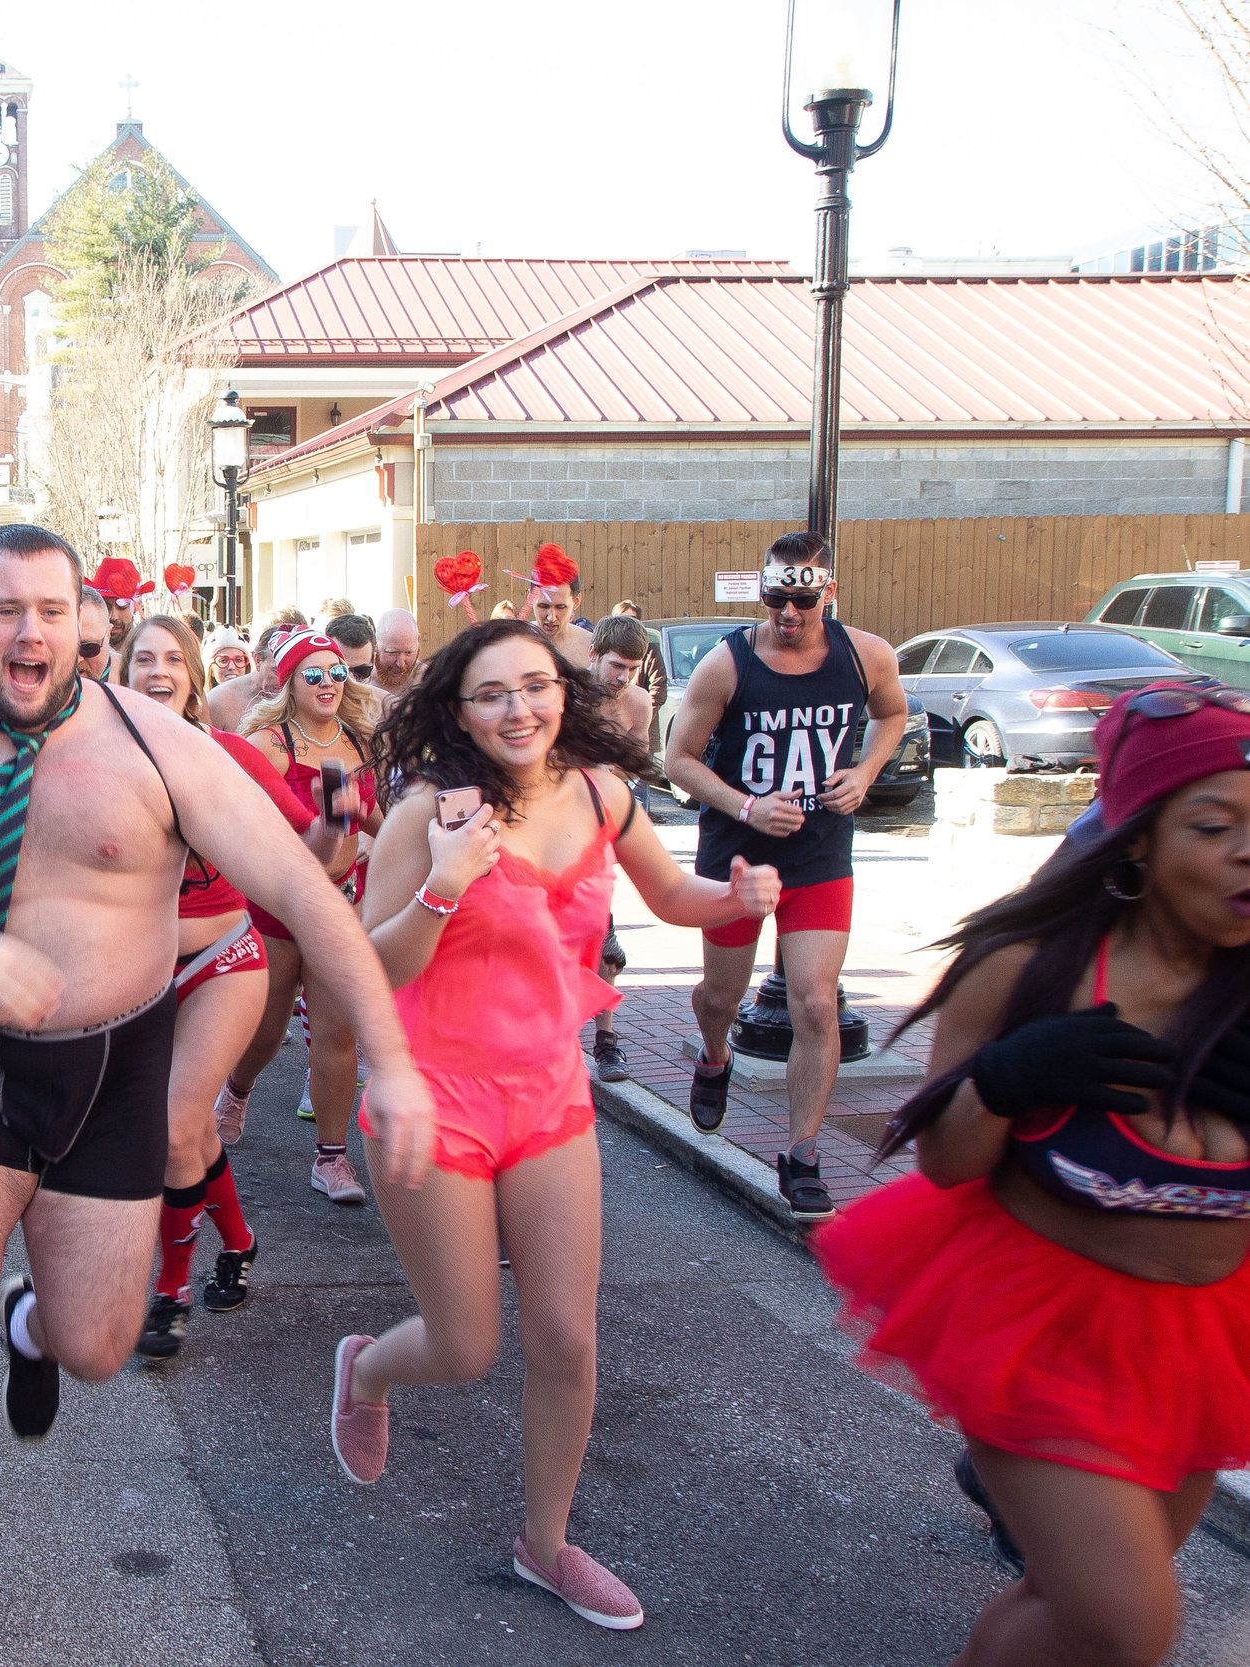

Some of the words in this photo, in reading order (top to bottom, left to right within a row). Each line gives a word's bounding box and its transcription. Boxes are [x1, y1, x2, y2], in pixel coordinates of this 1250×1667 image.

[781, 566, 814, 587] 30
[308, 635, 332, 647] C
[743, 708, 787, 732] I'M
[791, 702, 854, 728] NOT
[741, 725, 850, 796] GAY
